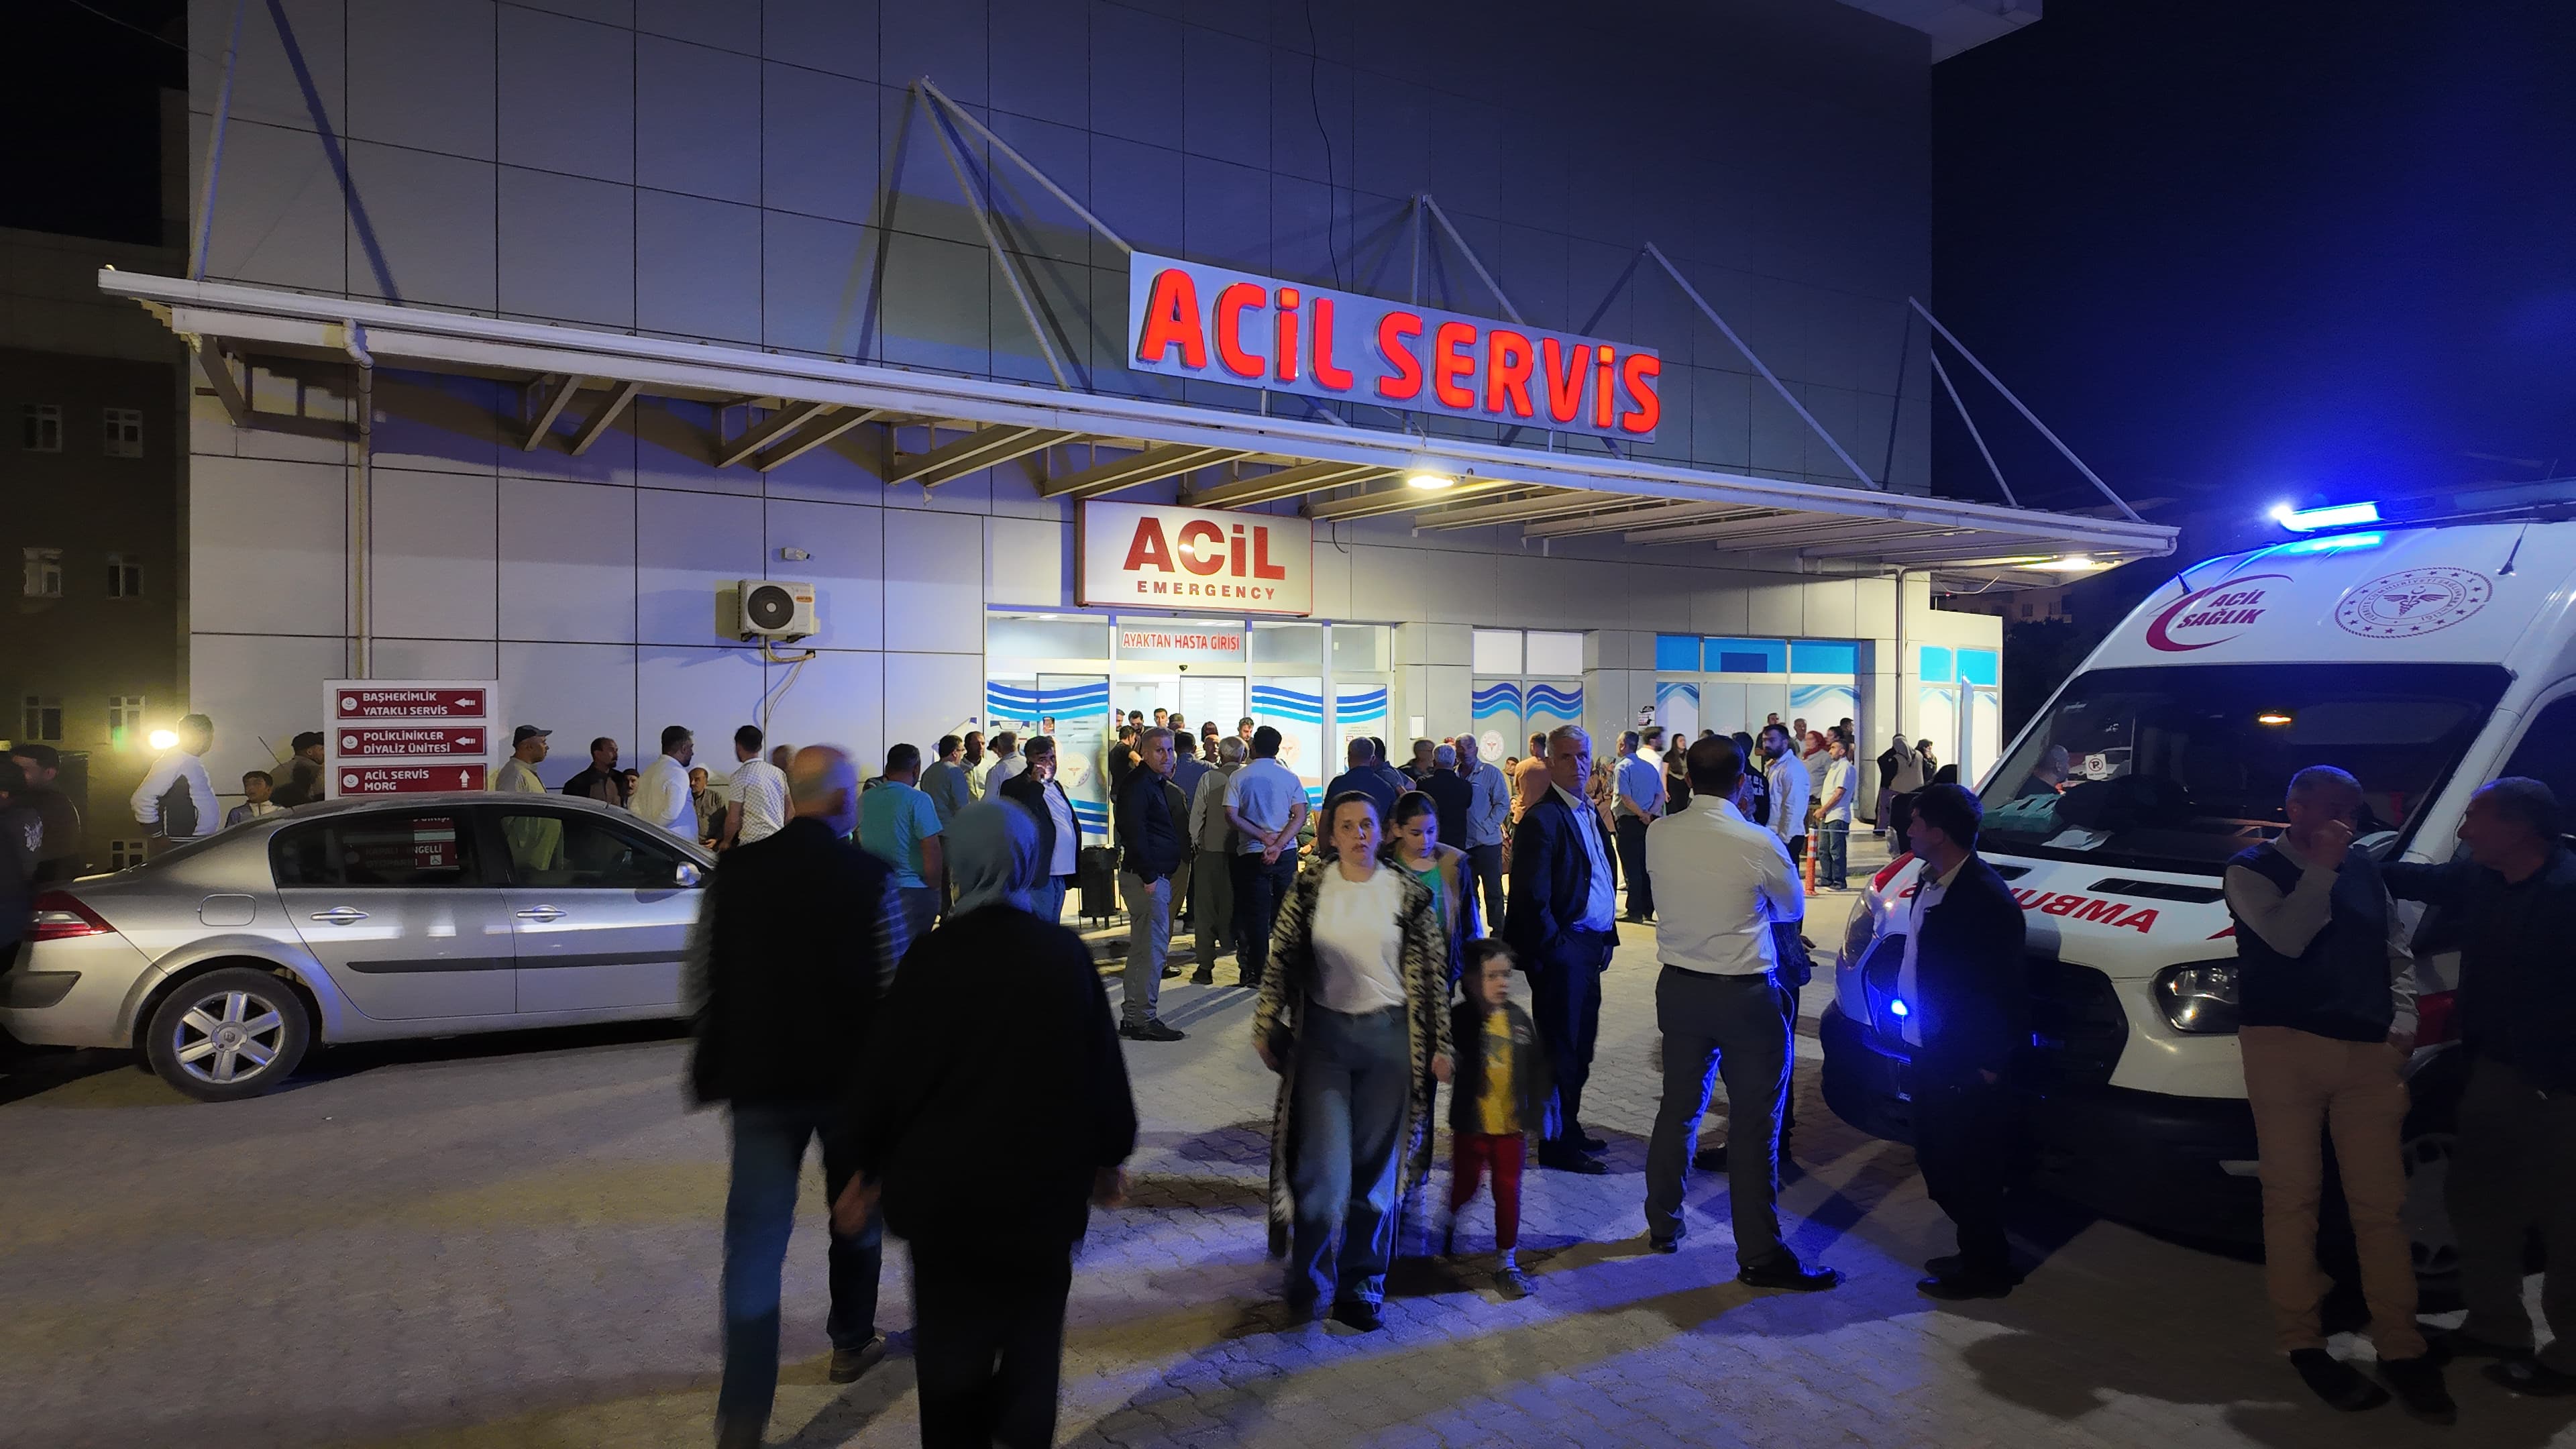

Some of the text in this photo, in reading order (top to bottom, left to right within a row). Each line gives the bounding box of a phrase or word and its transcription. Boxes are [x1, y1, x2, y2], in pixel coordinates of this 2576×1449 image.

[1137, 580, 1275, 600] EMERGENCY
[2176, 606, 2267, 629] SAĞLIK
[1123, 631, 1240, 653] AYAKTAN HASTA GİRİŞİ
[363, 690, 437, 703] BAŞHEKİMLİK
[363, 704, 448, 716] YATAKLI SERVİS
[364, 730, 444, 741] POLİKLİNİKLER
[364, 743, 451, 754] DİYALİZ ÜNİTESİ
[364, 768, 429, 780] ACİL SERVİS
[364, 782, 396, 791] MORG
